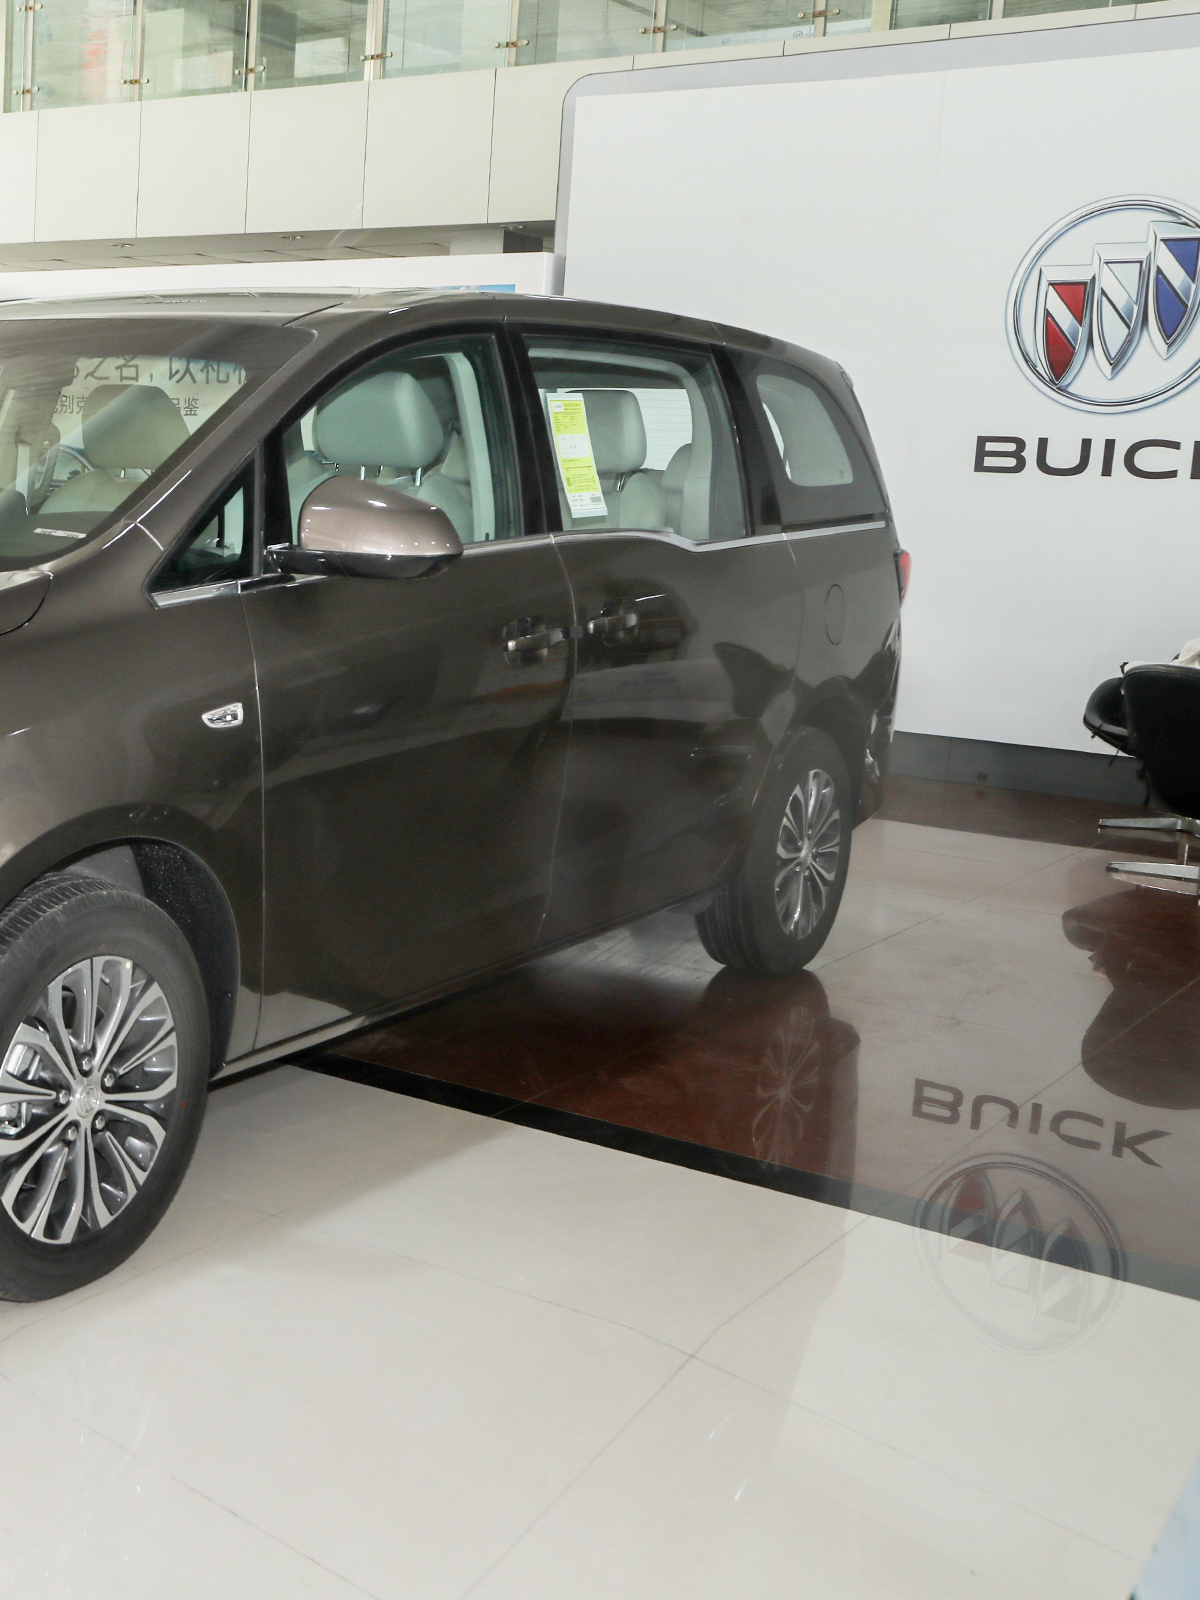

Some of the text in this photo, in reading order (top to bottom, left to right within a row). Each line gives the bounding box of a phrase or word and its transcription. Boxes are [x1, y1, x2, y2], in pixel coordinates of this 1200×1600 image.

[74, 355, 246, 384] 之名，以礼
[973, 435, 1200, 480] BUIC
